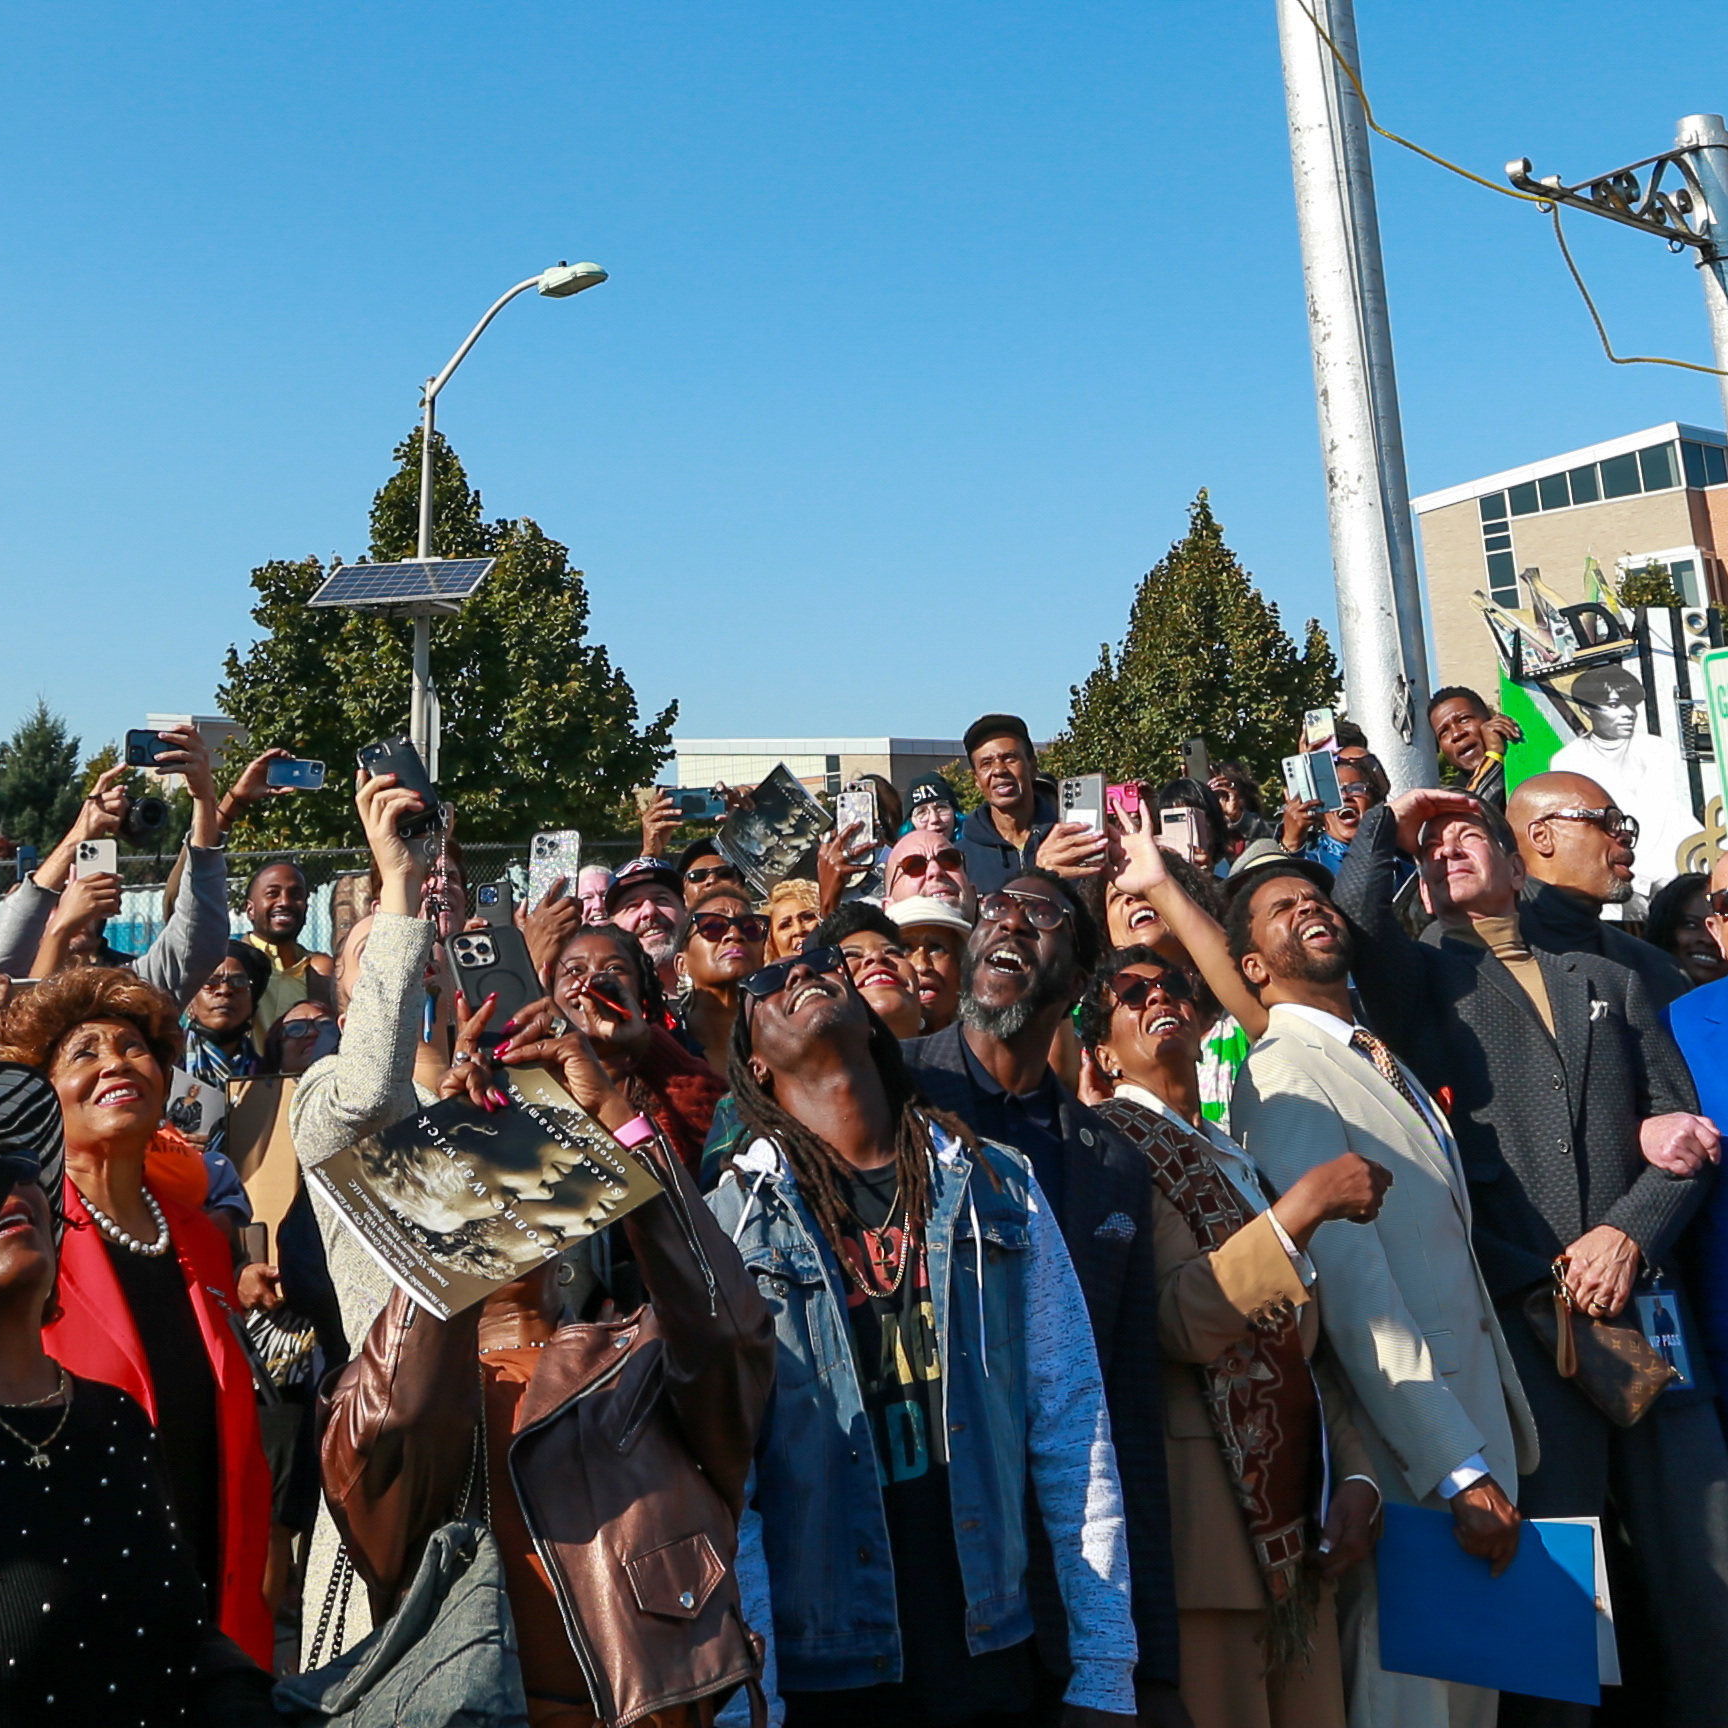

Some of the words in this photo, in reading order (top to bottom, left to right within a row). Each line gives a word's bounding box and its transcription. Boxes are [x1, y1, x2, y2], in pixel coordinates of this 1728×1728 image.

[912, 784, 939, 803] SIX
[504, 1082, 573, 1151] Renaming
[535, 1086, 562, 1114] 2024
[414, 1113, 489, 1198] Warwick
[574, 1152, 623, 1198] Street
[578, 1129, 627, 1175] October
[492, 1198, 559, 1260] Dionne
[1662, 1334, 1681, 1346] PASS
